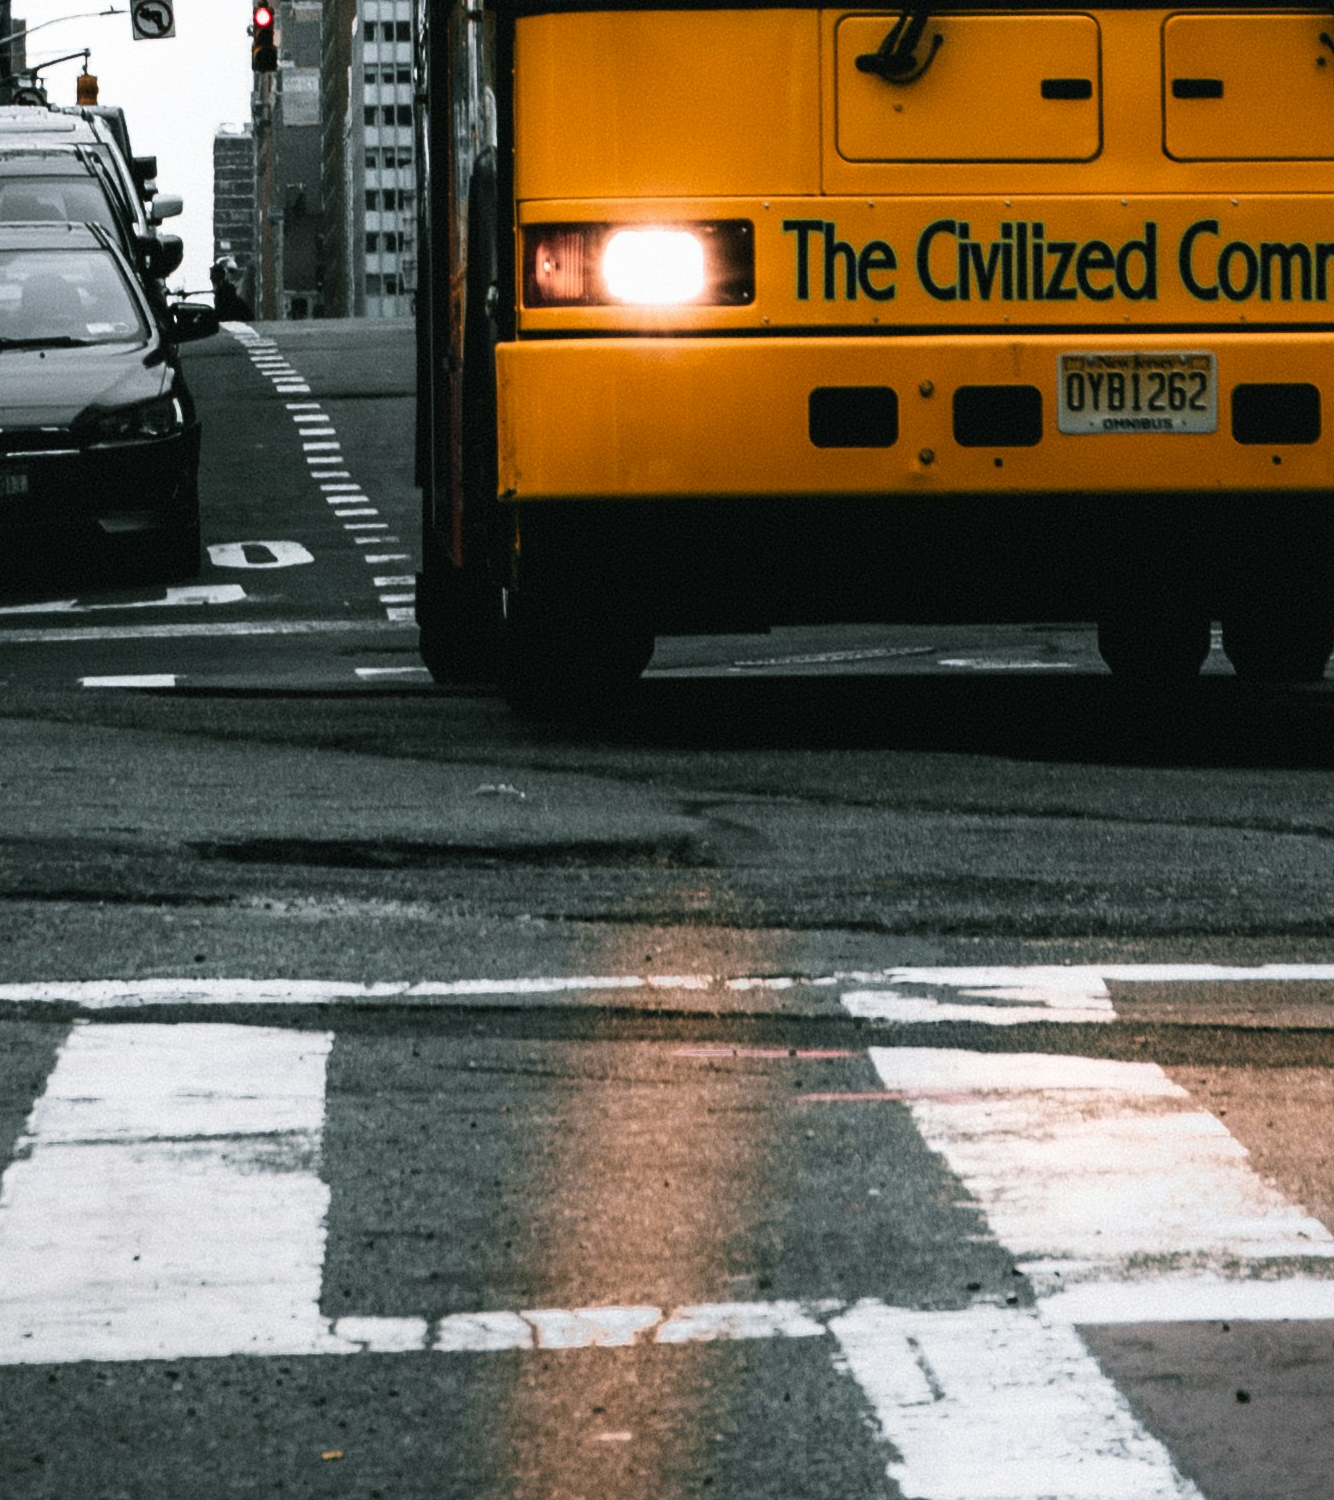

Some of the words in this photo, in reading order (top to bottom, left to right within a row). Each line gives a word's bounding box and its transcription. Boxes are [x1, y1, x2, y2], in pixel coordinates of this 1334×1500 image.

[783, 219, 897, 302] The
[916, 219, 1158, 302] Civilized
[1101, 417, 1174, 430] OMNIBUS
